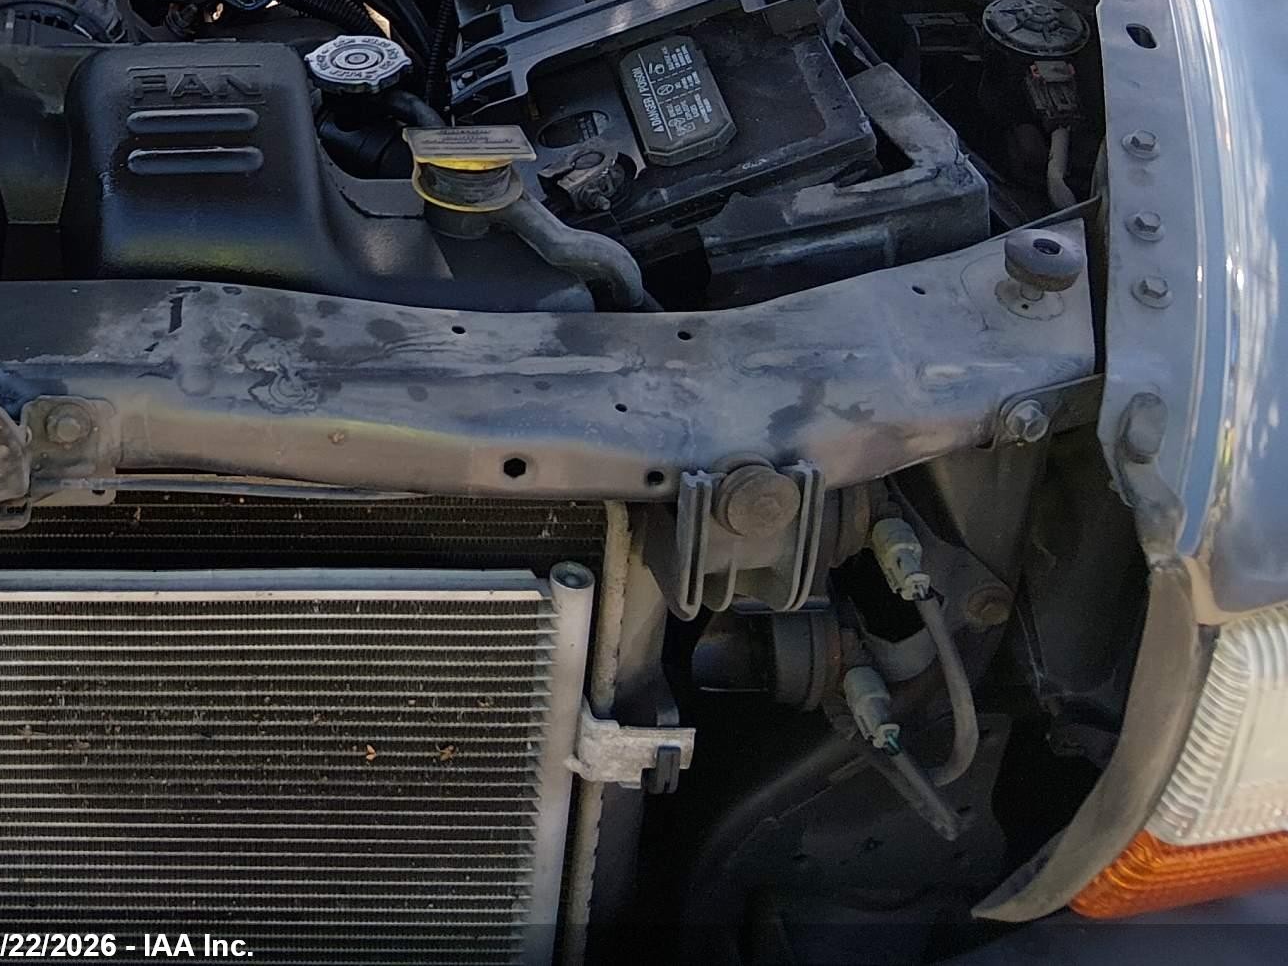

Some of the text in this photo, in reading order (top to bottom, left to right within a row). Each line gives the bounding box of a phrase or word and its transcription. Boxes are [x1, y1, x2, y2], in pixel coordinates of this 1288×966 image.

[130, 72, 263, 100] FAN
[631, 66, 649, 94] POISON
[642, 96, 663, 127] DANGER
